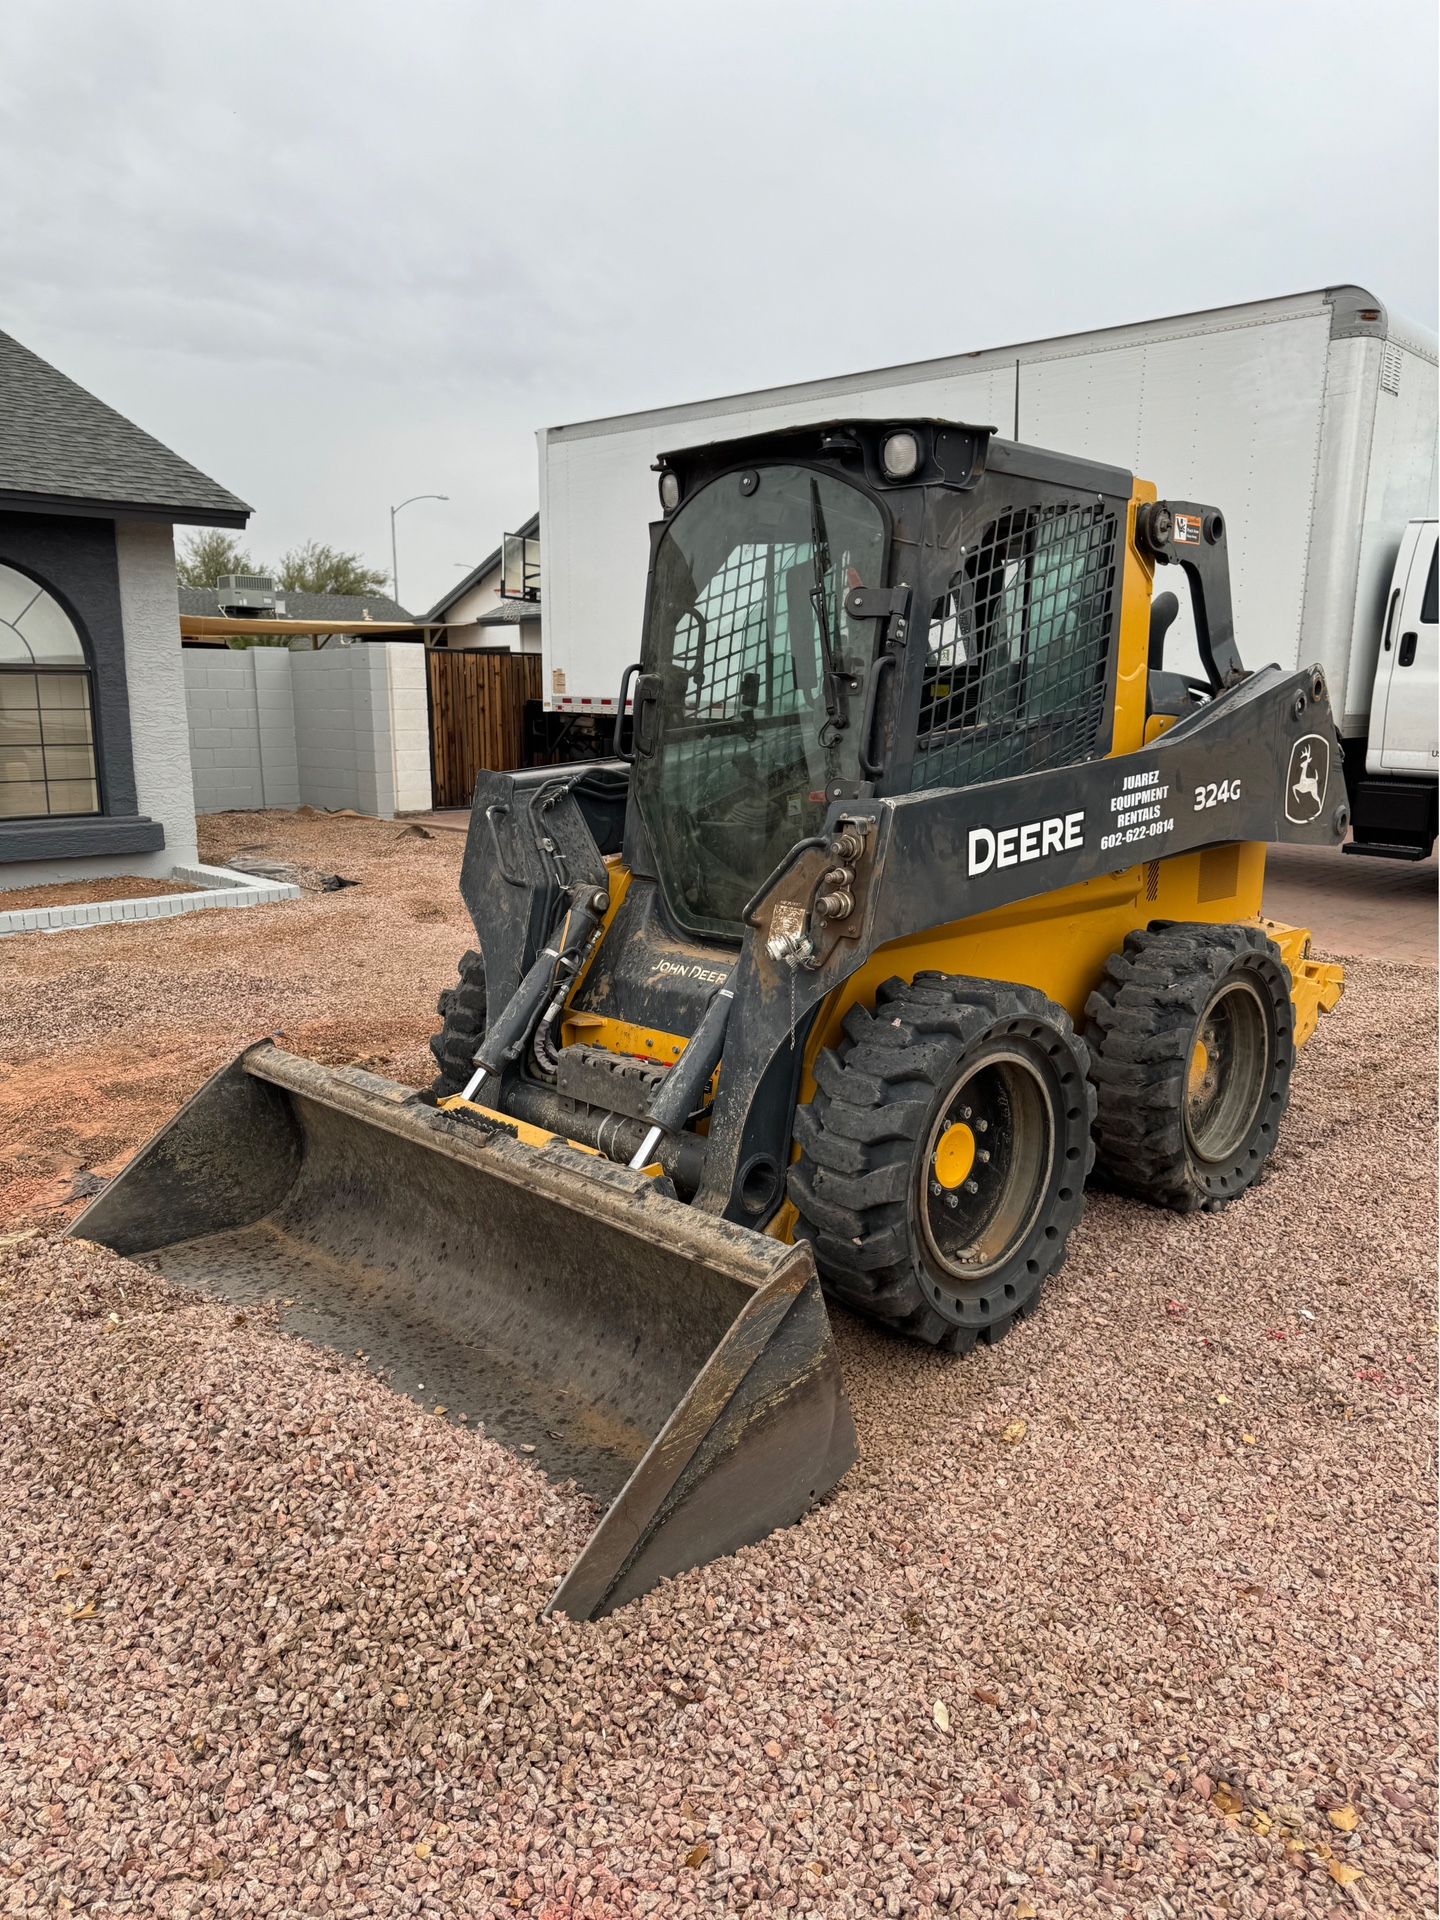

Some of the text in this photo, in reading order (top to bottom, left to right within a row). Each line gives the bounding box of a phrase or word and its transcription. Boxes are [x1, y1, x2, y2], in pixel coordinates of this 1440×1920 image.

[1123, 770, 1160, 791] JUAREZ
[1110, 785, 1170, 812] EQUIPMENT
[1194, 779, 1241, 811] 324G
[1117, 805, 1161, 828] RENTALS
[968, 811, 1085, 876] DEERE
[1100, 818, 1174, 850] 602-622-0814
[651, 959, 728, 985] JOHN DEER
